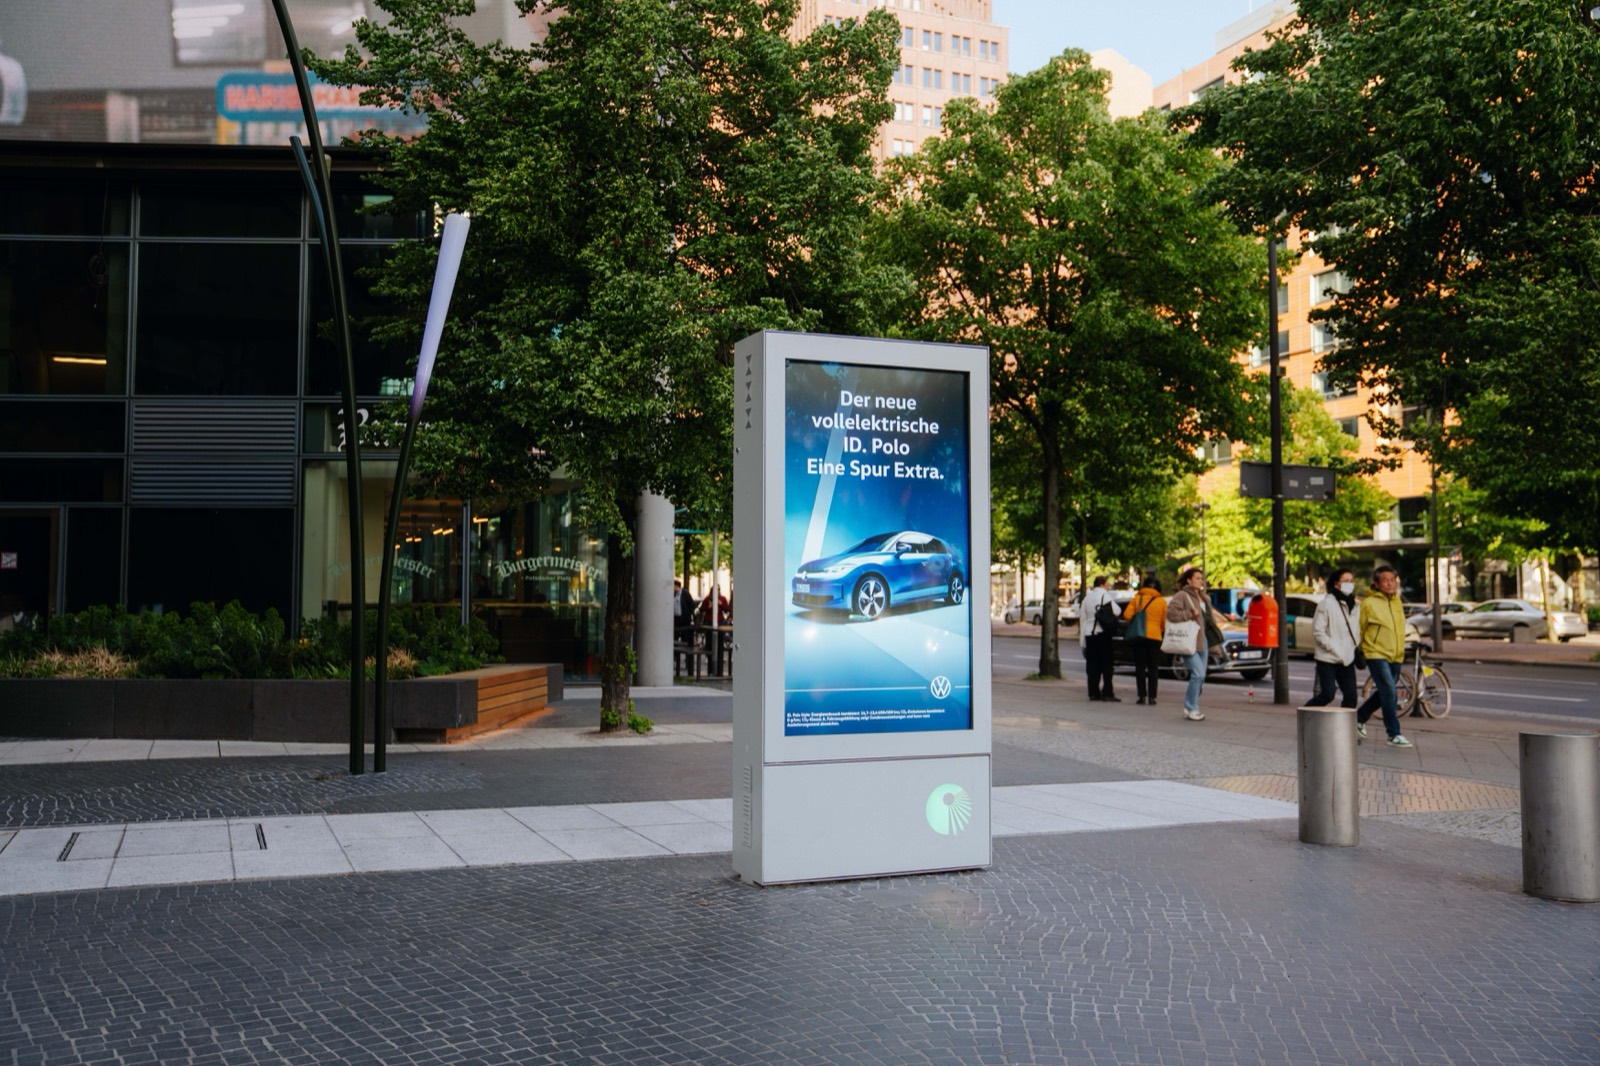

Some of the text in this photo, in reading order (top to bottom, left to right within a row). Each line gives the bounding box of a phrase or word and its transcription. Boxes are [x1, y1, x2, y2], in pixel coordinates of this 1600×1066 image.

[840, 390, 917, 410] Der neue
[811, 413, 939, 434] vollelektrische
[843, 436, 910, 456] ID. Polo
[807, 458, 945, 481] Eine Spur Extra.
[494, 555, 602, 579] Burgermeister
